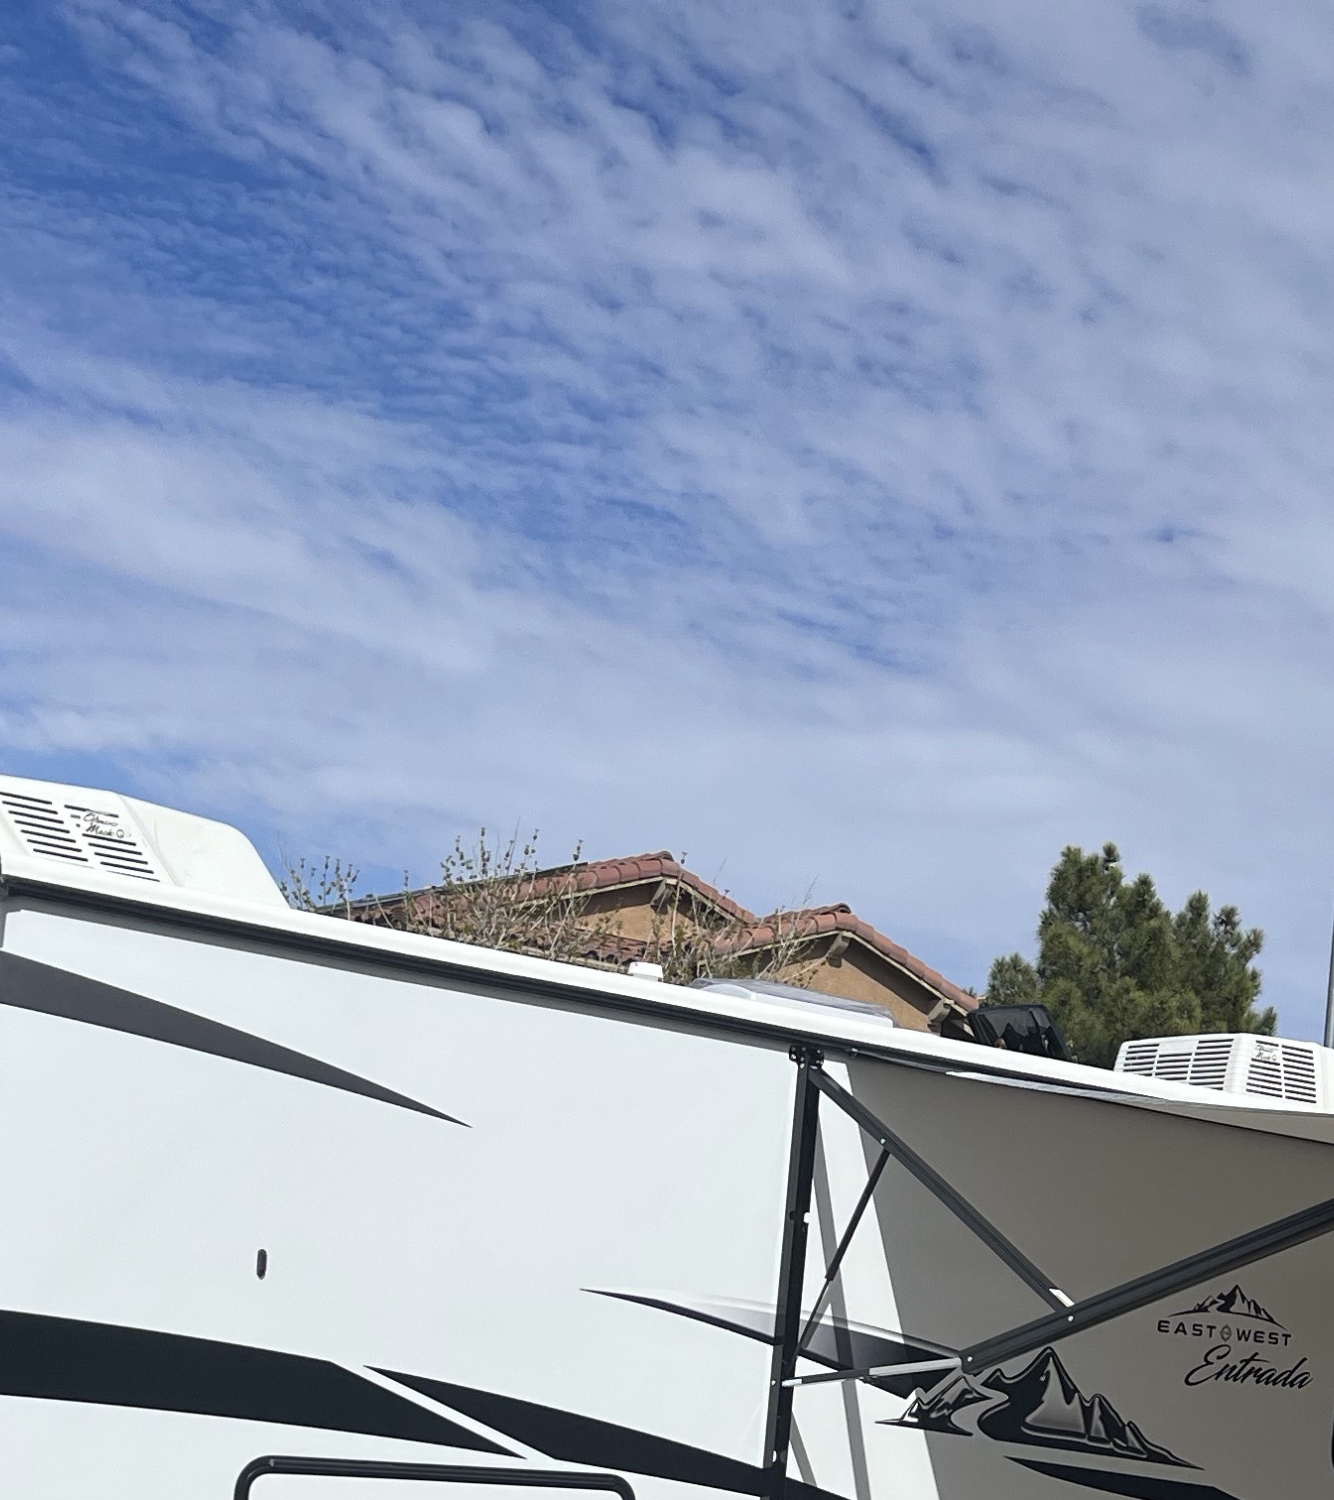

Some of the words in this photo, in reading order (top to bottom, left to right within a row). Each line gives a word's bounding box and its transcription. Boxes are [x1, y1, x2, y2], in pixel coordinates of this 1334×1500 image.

[1157, 1320, 1216, 1338] EAST
[1237, 1328, 1292, 1346] WEST
[1184, 1345, 1314, 1389] Entrada
